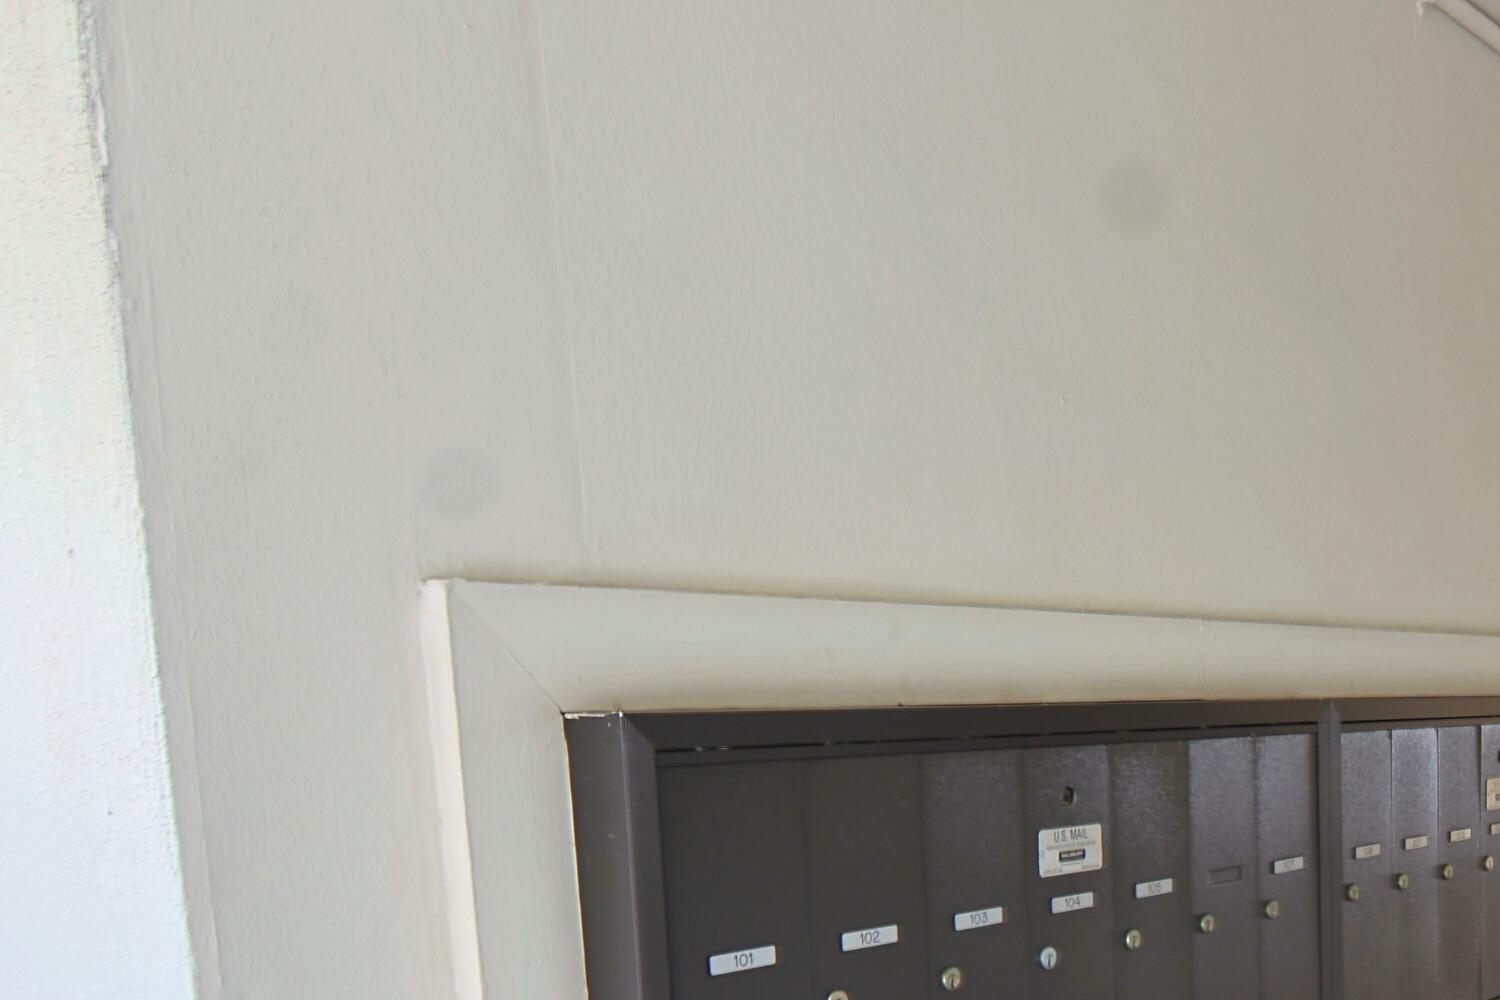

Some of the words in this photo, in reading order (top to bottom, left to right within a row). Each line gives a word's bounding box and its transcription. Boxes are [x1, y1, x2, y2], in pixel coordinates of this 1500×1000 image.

[1070, 826, 1089, 841] MAIL
[1064, 893, 1081, 908] 104
[969, 911, 989, 926] 103
[859, 930, 881, 946] 102
[733, 951, 755, 968] 101
